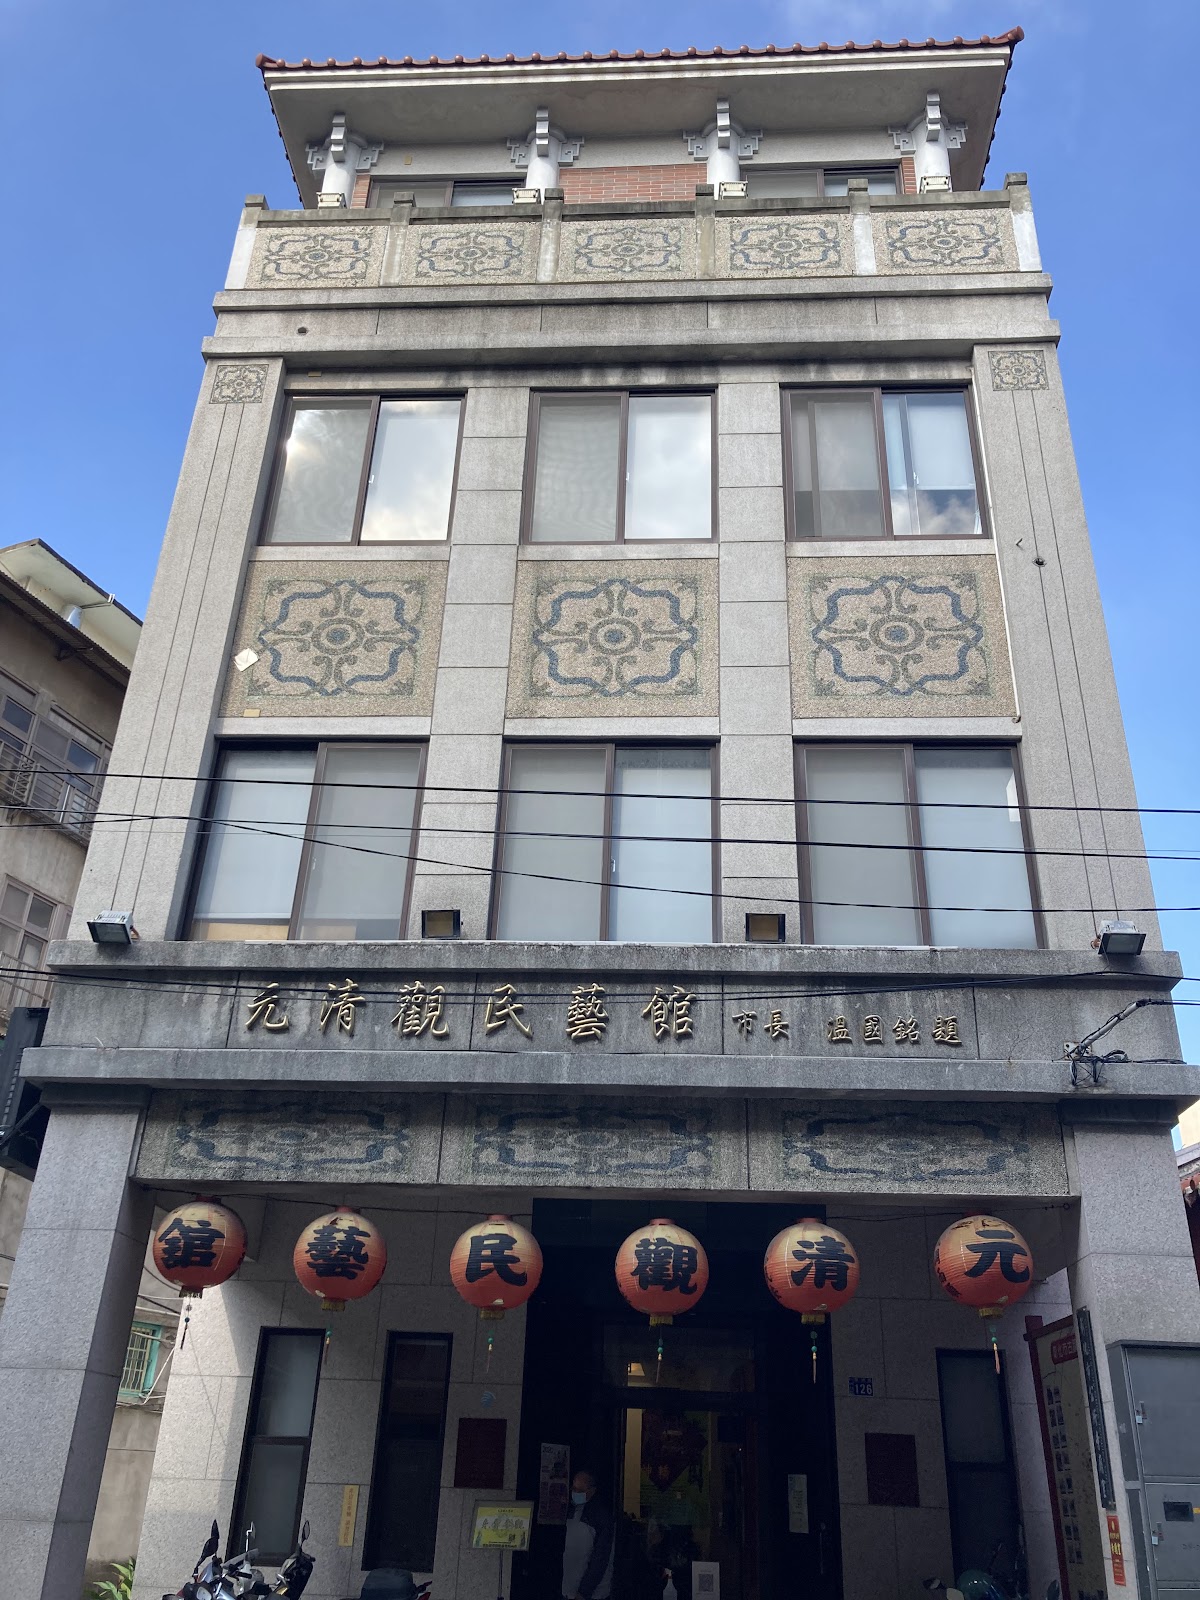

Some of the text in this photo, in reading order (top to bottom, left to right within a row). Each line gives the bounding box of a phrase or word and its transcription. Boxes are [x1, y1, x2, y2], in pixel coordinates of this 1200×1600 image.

[245, 978, 697, 1038] 元清觀民藝館
[732, 1009, 789, 1040] 市長
[305, 1224, 371, 1280] 藝
[465, 1232, 528, 1287] 民
[630, 1237, 698, 1295] 觀
[790, 1235, 856, 1292] 清
[964, 1229, 1030, 1284] 元
[854, 1383, 873, 1395] 126
